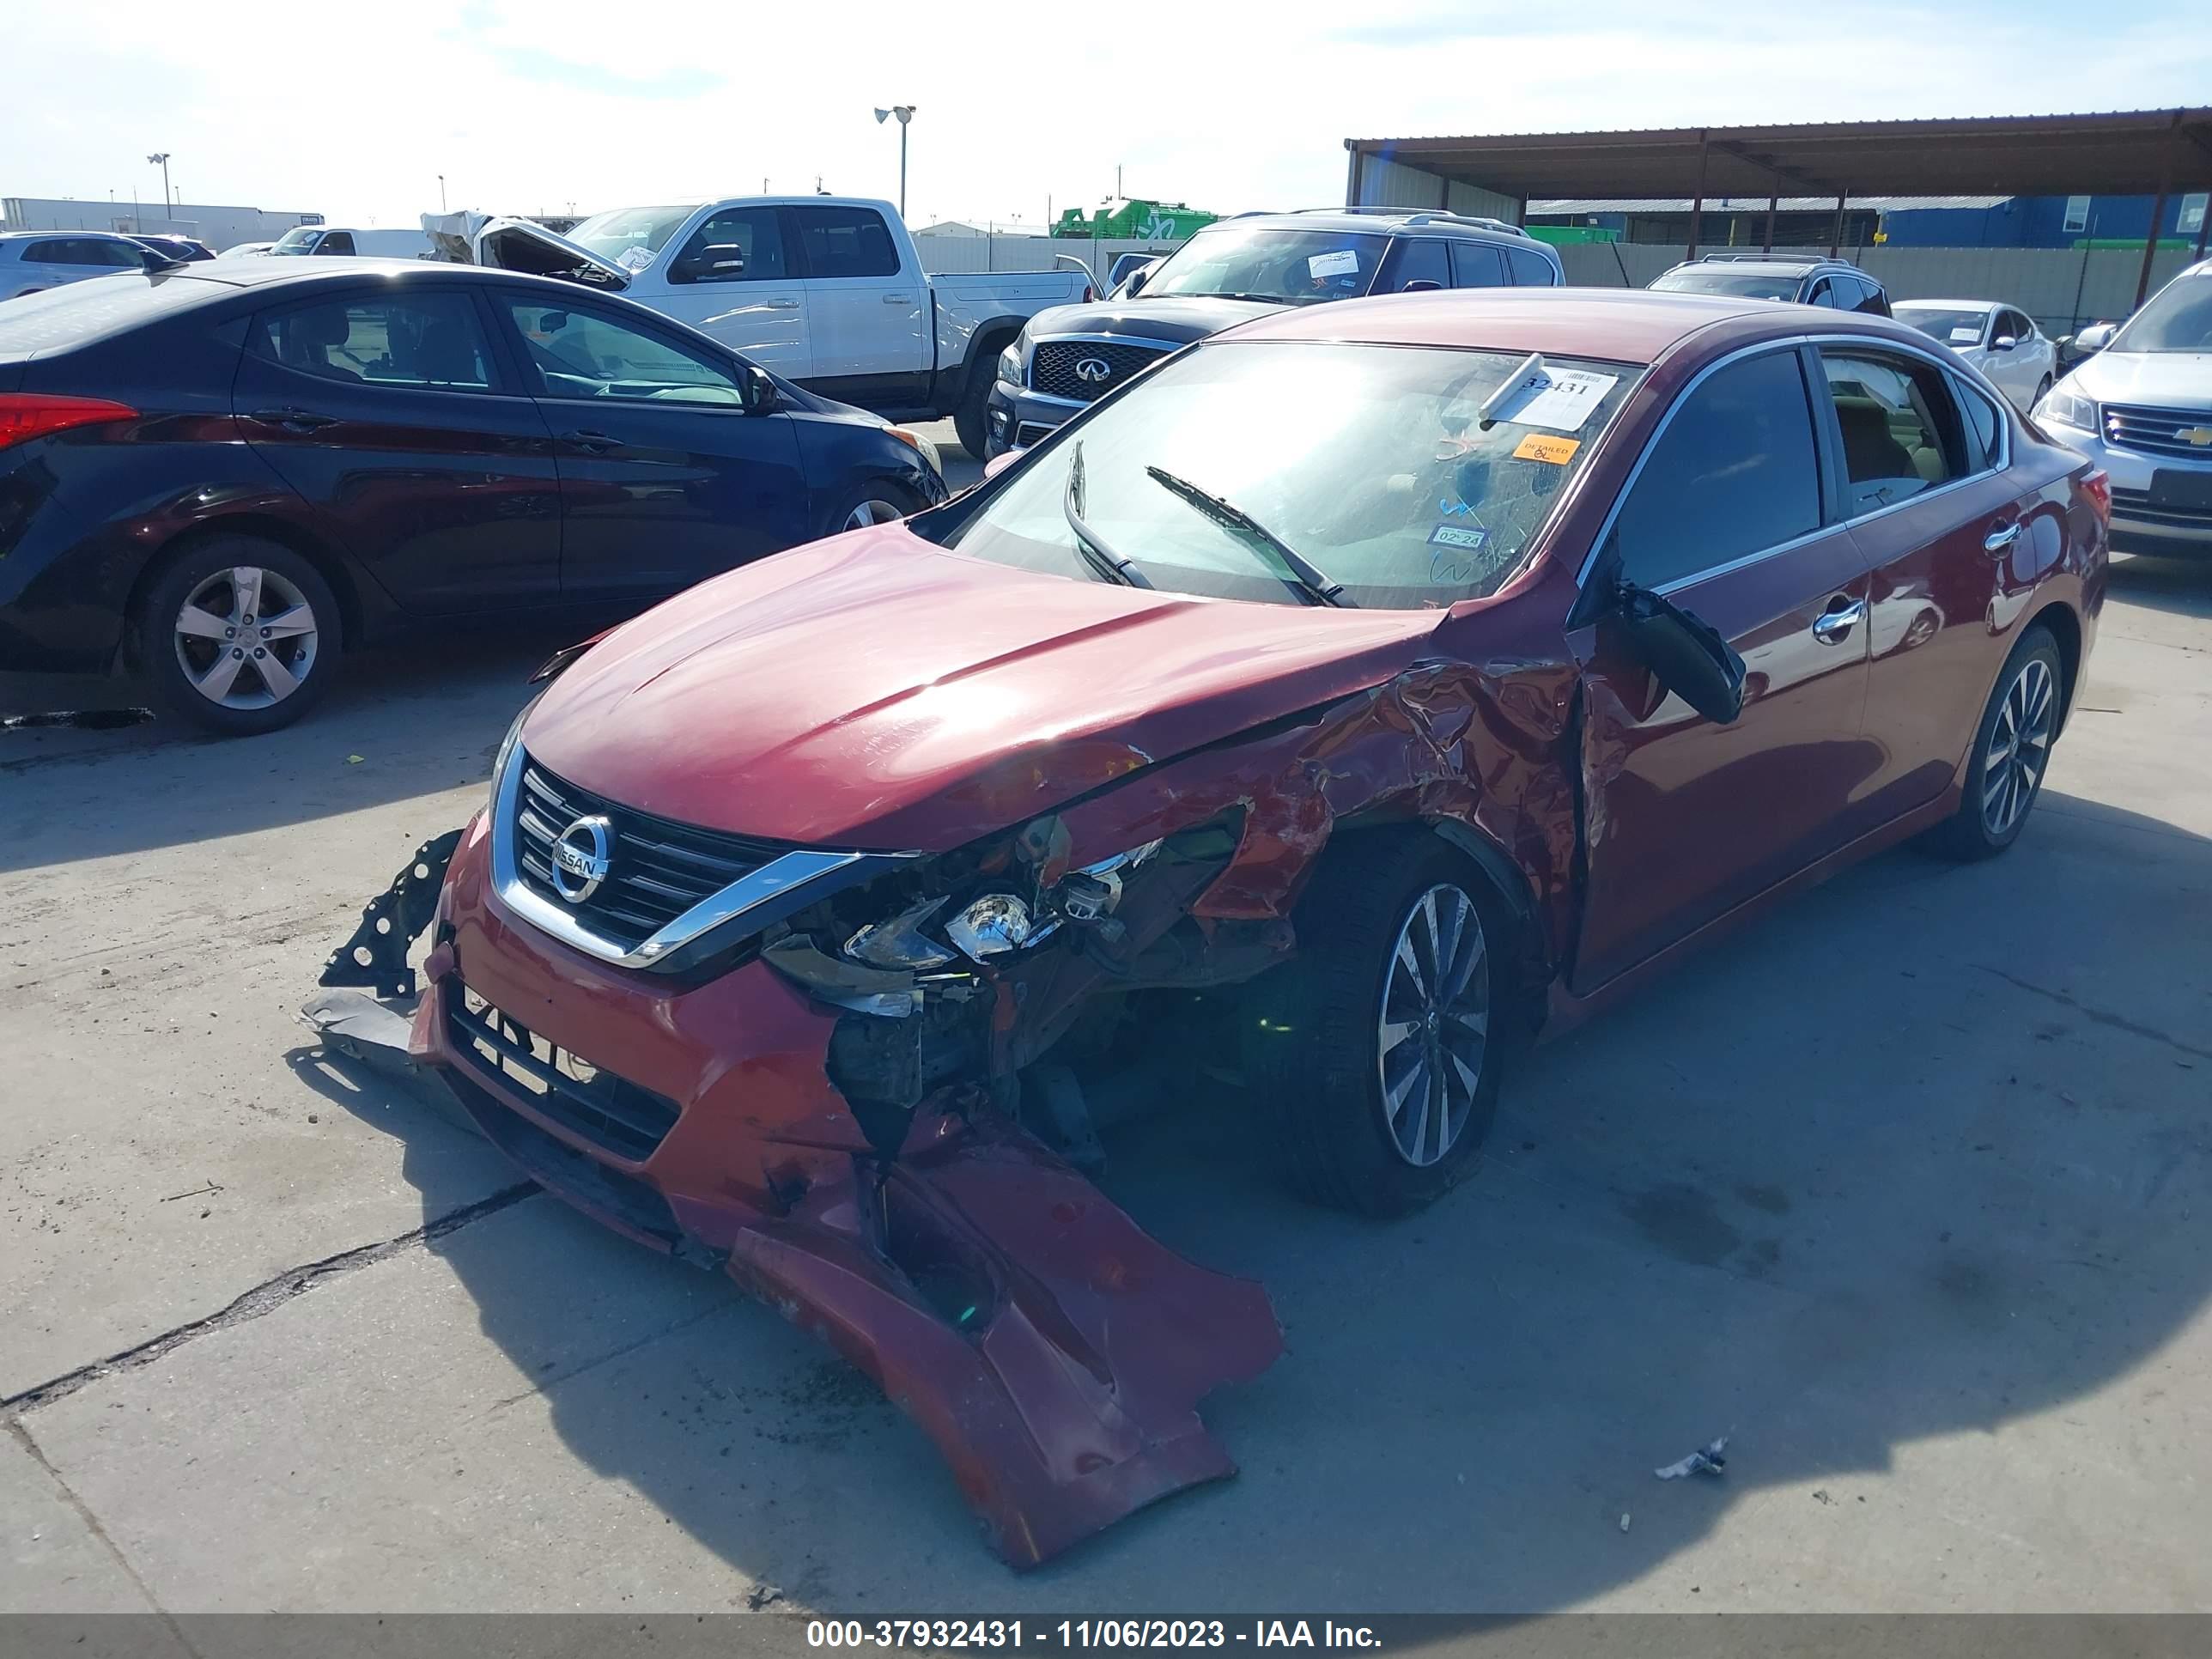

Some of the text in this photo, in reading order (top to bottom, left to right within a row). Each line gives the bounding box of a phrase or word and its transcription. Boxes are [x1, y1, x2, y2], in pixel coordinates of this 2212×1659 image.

[1439, 532, 1480, 545] 02 24
[555, 844, 596, 875] NISSAN
